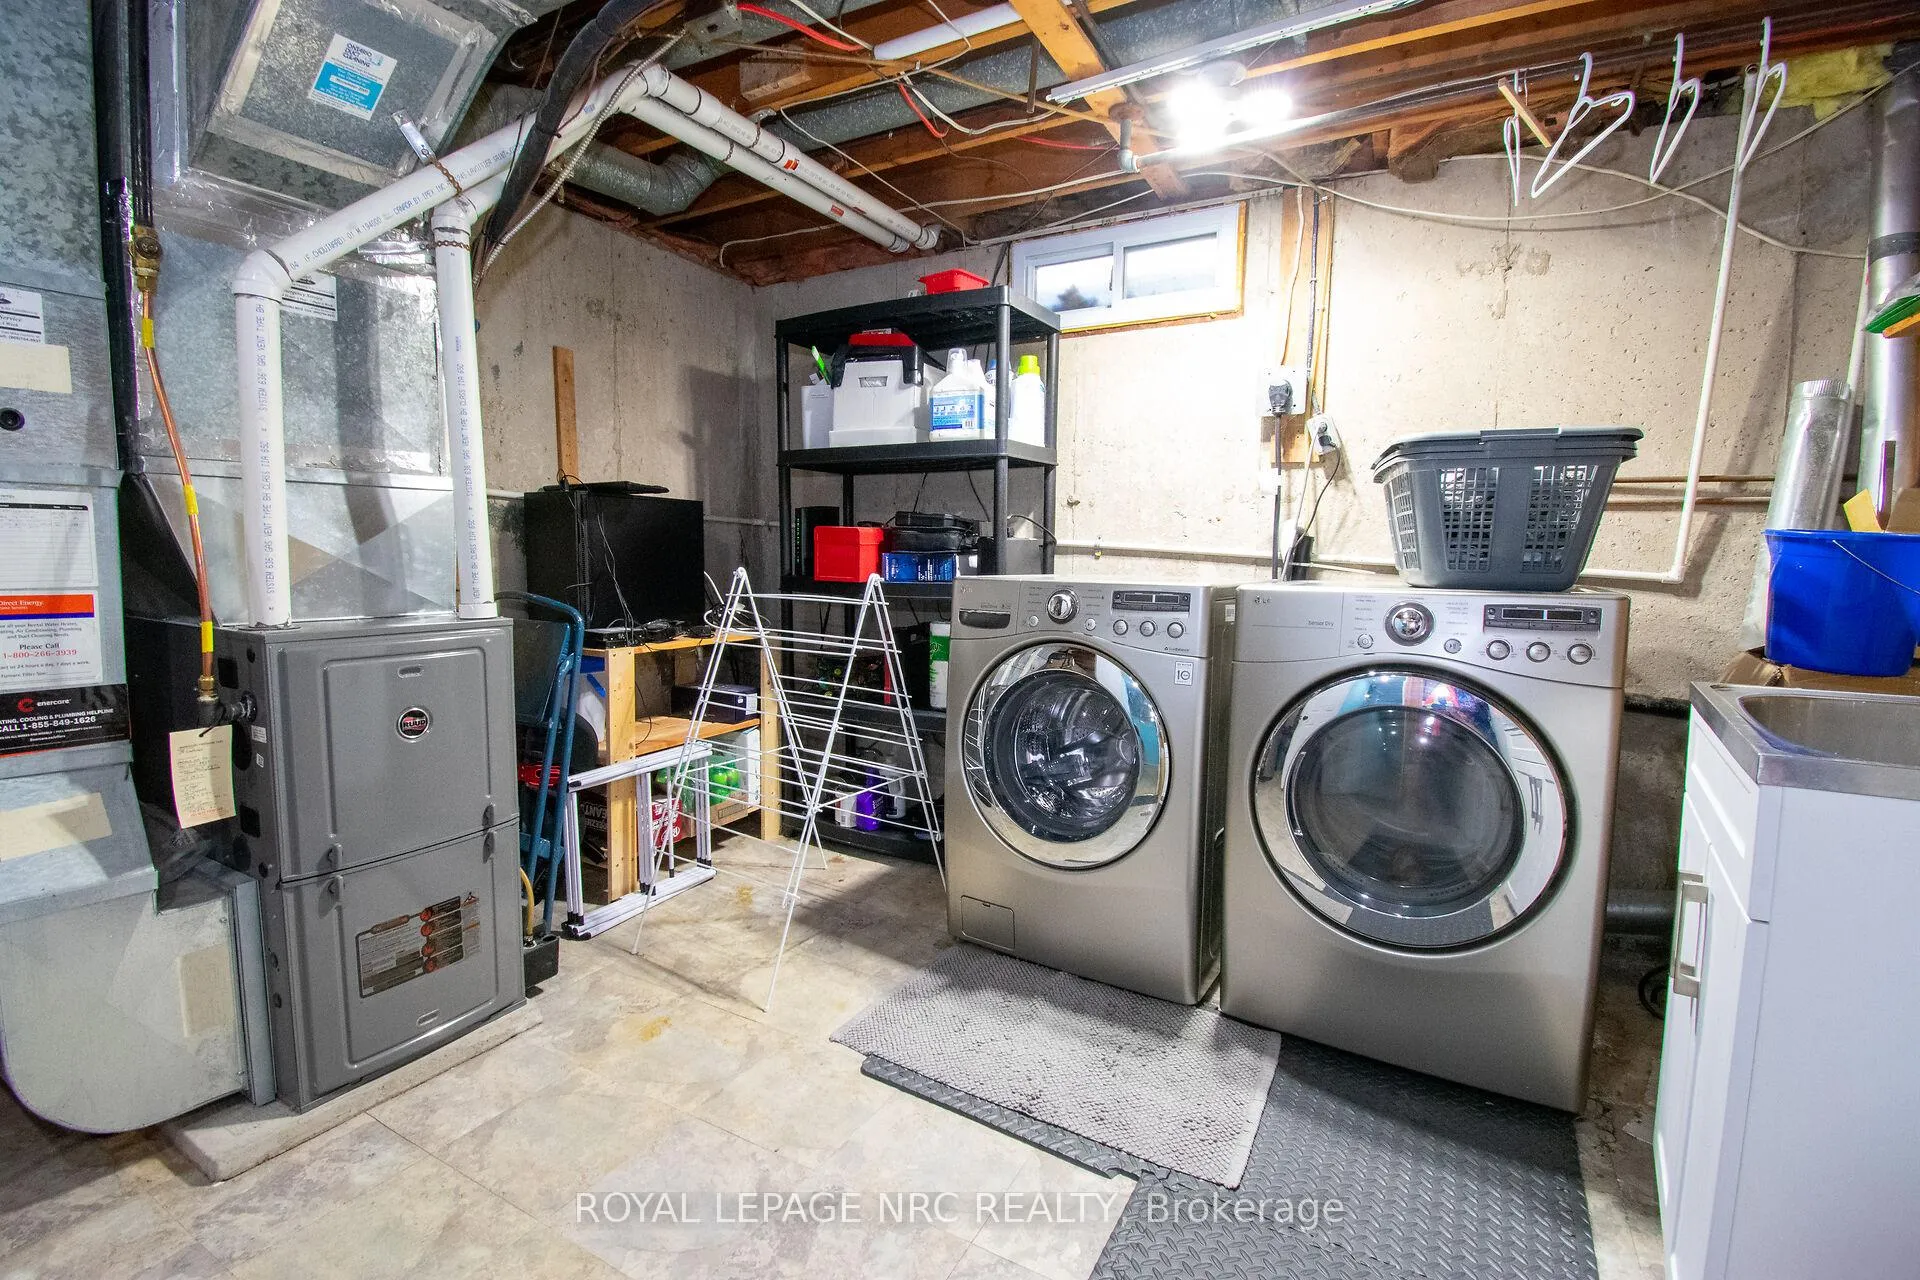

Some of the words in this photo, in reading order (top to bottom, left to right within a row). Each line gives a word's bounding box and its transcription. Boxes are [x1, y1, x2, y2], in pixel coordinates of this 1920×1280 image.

[266, 570, 275, 594] SYSTEM
[3, 649, 77, 659] 1-800-266-3939
[37, 699, 71, 707] enercare
[54, 711, 86, 719] PLUMBING
[86, 708, 114, 716] HELPLINE
[22, 716, 97, 730] 1-855-849-1626
[403, 719, 426, 728] RUUD
